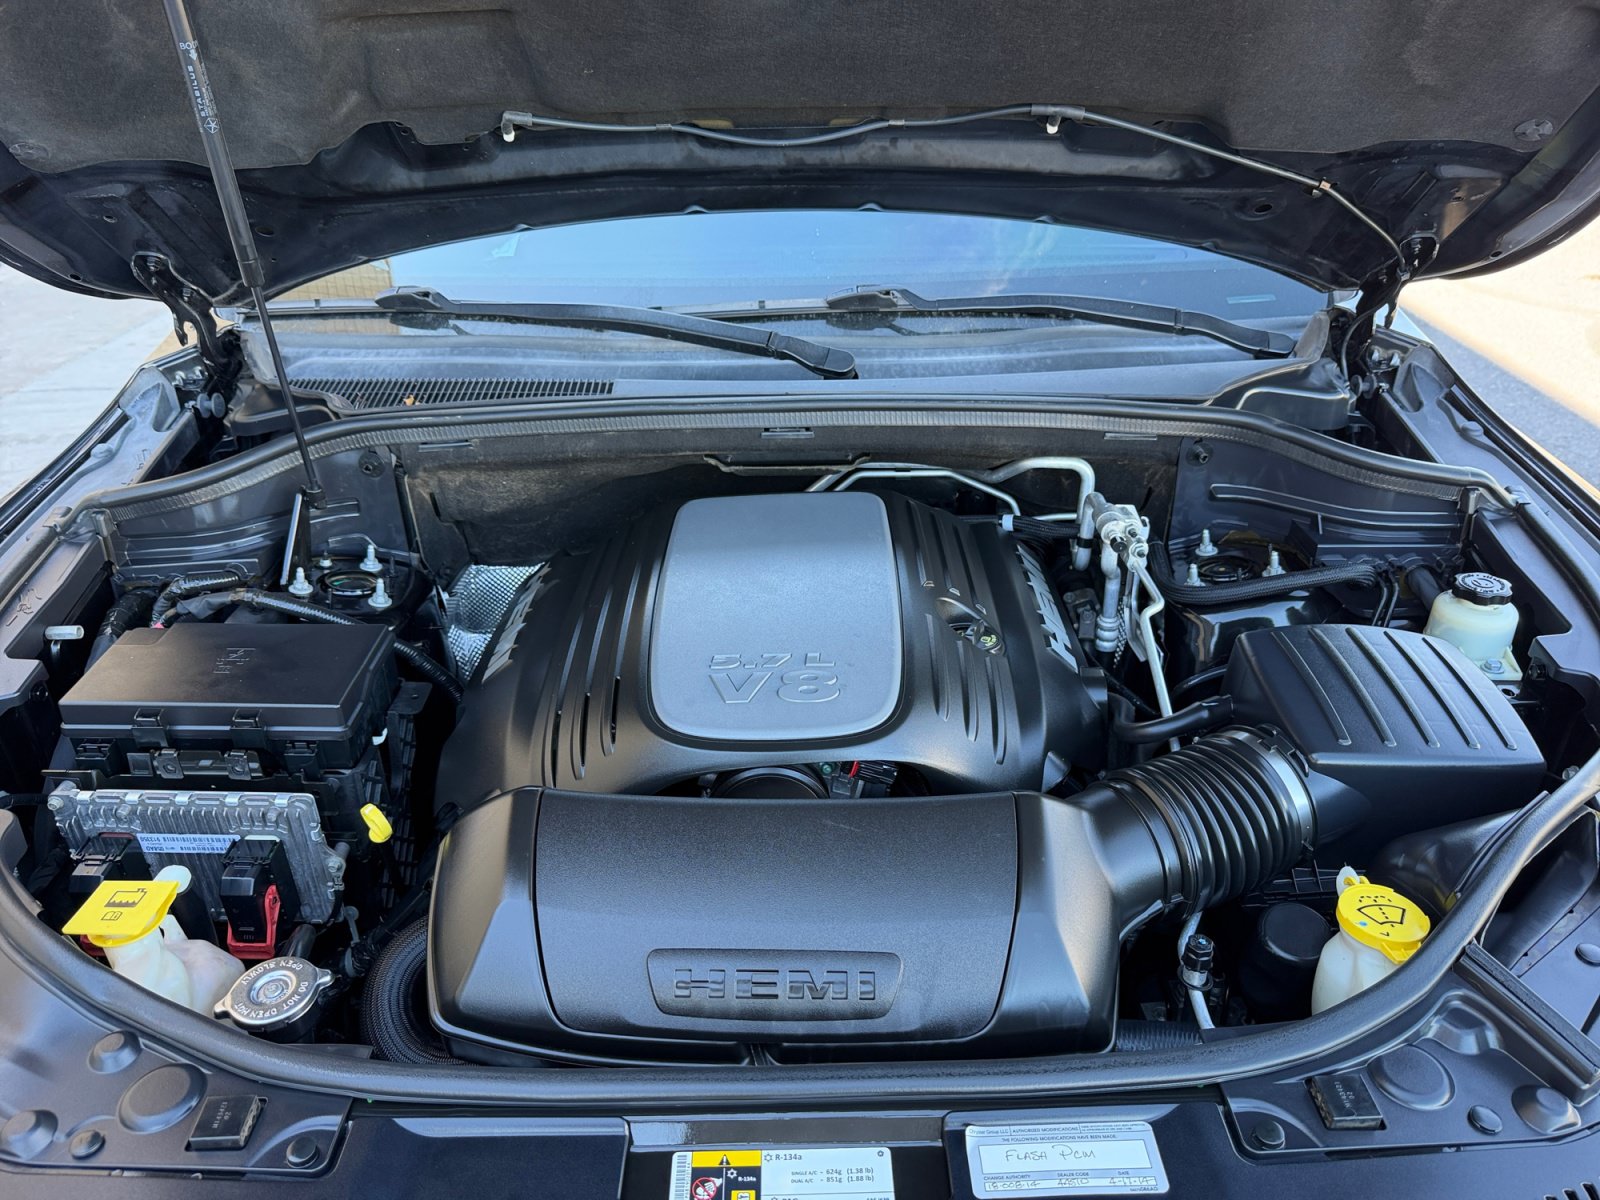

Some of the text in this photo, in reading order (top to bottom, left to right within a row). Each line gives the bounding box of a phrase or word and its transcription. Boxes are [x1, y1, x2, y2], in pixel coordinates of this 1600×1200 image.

[187, 65, 207, 117] STABILUS
[1016, 544, 1078, 674] HEMI
[708, 669, 841, 704] V8
[241, 959, 303, 985] OPEN SLOWLY
[298, 981, 309, 993] DO
[674, 968, 876, 1000] HEMI
[234, 1002, 250, 1016] HOT
[282, 994, 300, 1010] NOT
[249, 1007, 278, 1018] OPEN
[775, 1152, 802, 1161] R-134a
[1005, 1143, 1096, 1162] FLASH PCM
[826, 1168, 843, 1176] 624g
[846, 1167, 863, 1175] (1.38
[864, 1167, 874, 1175] lb)
[826, 1176, 843, 1184] 851g
[847, 1175, 863, 1183] (1.88
[864, 1175, 875, 1183] lb)
